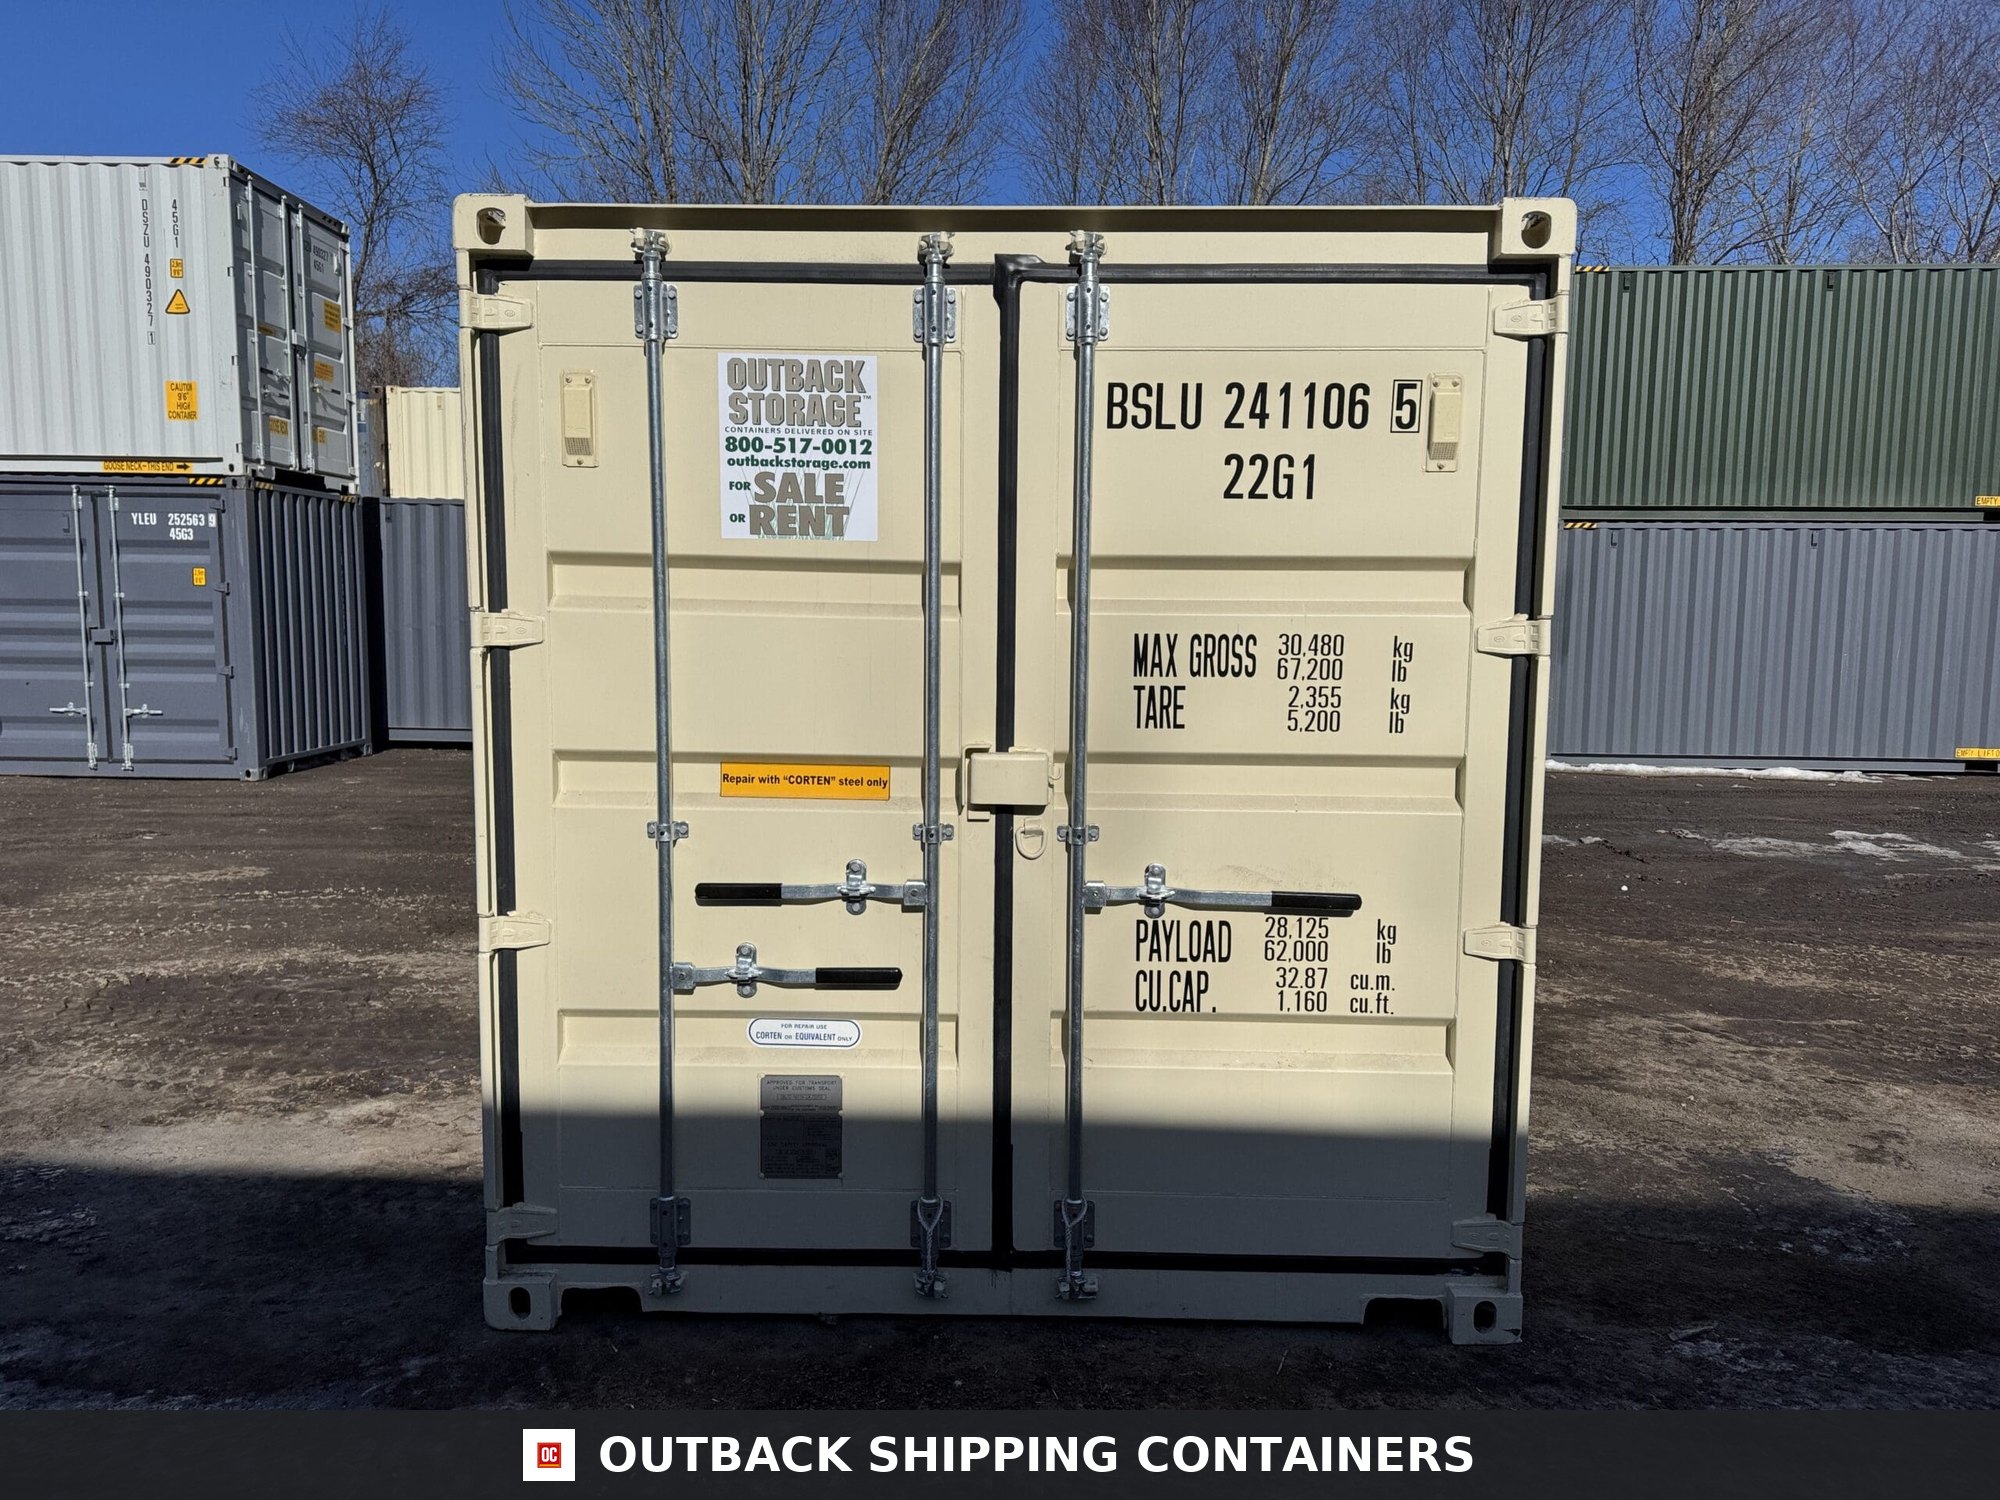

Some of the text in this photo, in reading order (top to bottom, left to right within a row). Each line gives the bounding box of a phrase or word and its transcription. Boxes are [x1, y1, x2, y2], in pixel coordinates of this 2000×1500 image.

[144, 253, 154, 326] 490327
[727, 357, 866, 393] OUTBACK
[728, 392, 862, 427] STORAGE
[1107, 382, 1418, 430] BSLU 241106 5
[725, 426, 781, 434] CONTAINERS
[784, 428, 834, 436] DELIVERED
[725, 436, 872, 455] 800-517-0012
[727, 454, 871, 471] outbackstorage.com
[729, 471, 845, 504] FOR SALE
[1223, 453, 1316, 500] 22G1
[131, 512, 157, 525] YLEU
[168, 513, 205, 526] 252563
[729, 504, 850, 537] OR RENT
[169, 528, 194, 540] 45G3
[1133, 633, 1414, 678] MAX GROSS 30,480 kg
[1277, 658, 1407, 682] 67,200 lb
[1133, 685, 1410, 729] TARE 2,355 kg
[1287, 710, 1405, 734] 5,200 lb
[722, 774, 755, 785] Repair
[758, 775, 780, 785] with
[838, 777, 863, 786] steel
[866, 778, 888, 789] only
[1135, 917, 1397, 962] PAYLOAD 28,125 kg
[1264, 940, 1392, 964] 62,000 lb
[1276, 967, 1328, 989] 32.87
[1350, 974, 1395, 991] cu.m.
[1278, 991, 1394, 1015] 1,160 cu.ft.
[756, 1031, 782, 1039] CORTEN
[795, 1032, 836, 1041] EQUIVALENT
